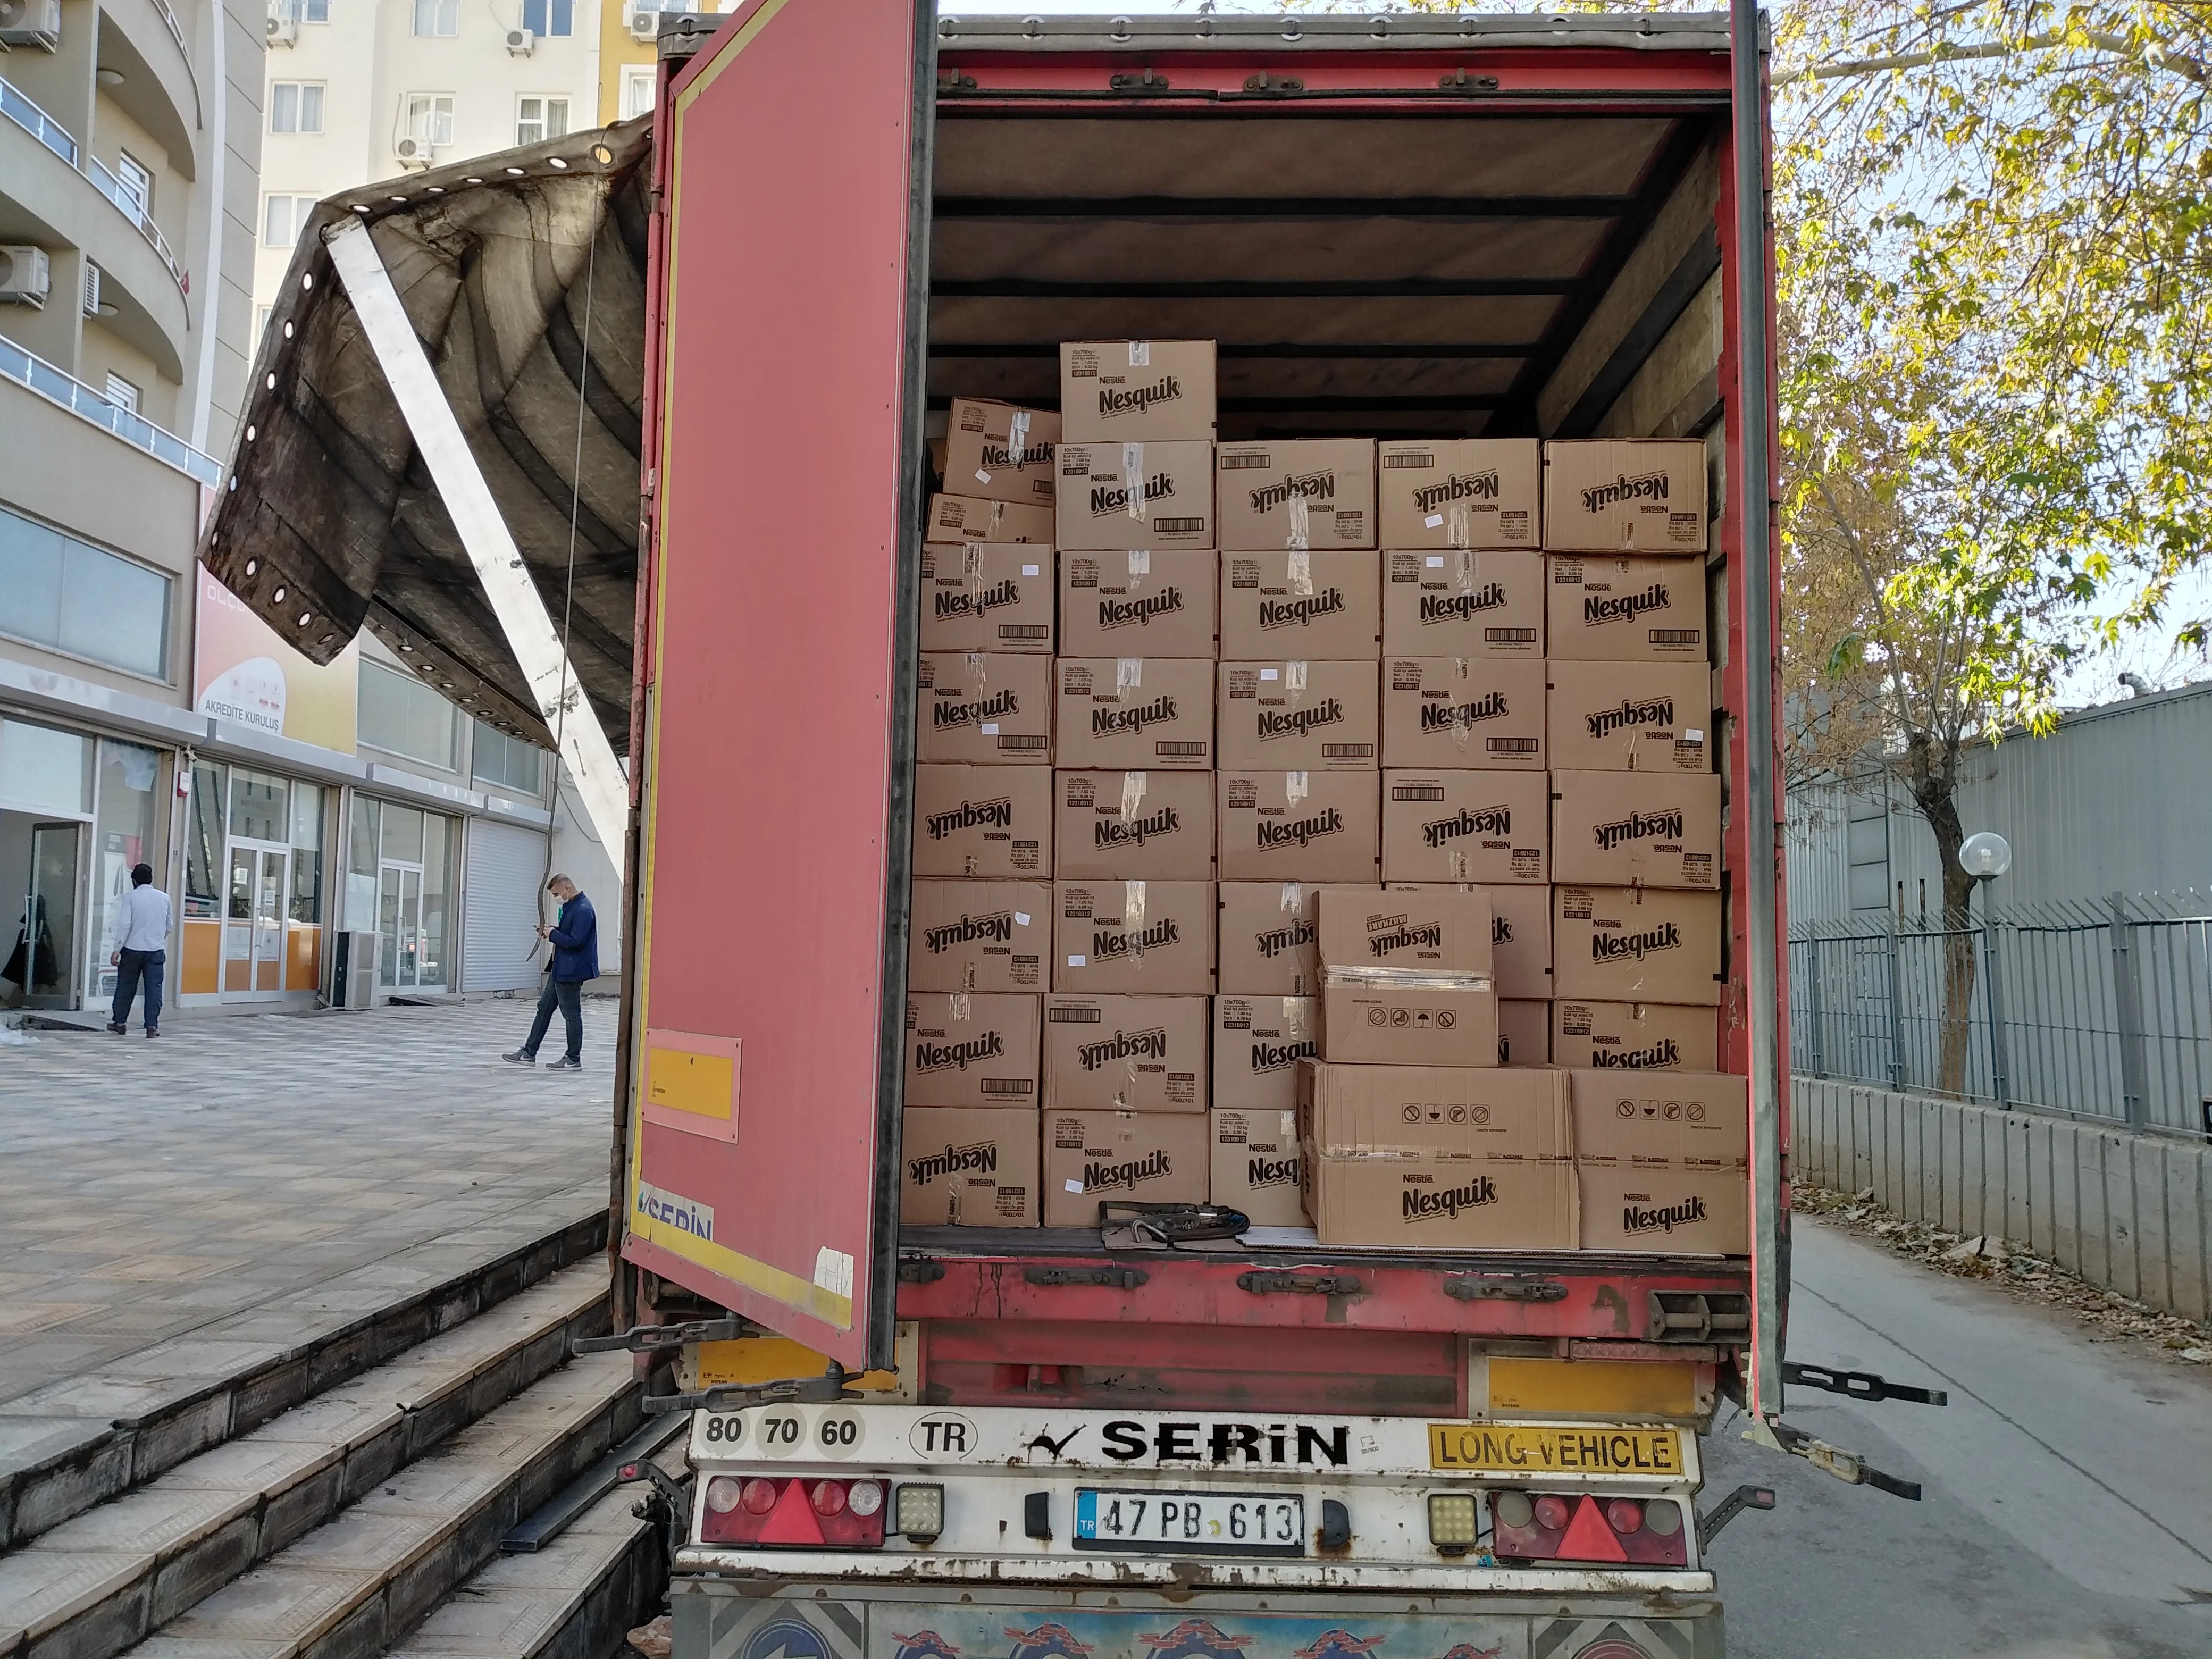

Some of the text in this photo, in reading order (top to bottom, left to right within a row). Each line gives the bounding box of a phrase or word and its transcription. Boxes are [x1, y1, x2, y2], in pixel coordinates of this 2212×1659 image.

[1099, 375, 1182, 414] Nesquik
[1412, 473, 1498, 513] Nesquik
[1580, 474, 1668, 513] Nesquik
[1100, 586, 1184, 625] Nesquik
[1260, 587, 1345, 626] Nesquik
[1420, 582, 1507, 621] Nesquik
[1585, 583, 1671, 622] Nesquik
[205, 699, 243, 720] AKREDİTE
[245, 710, 279, 733] KURULUŞ
[1092, 695, 1178, 734] Nesquik
[1258, 698, 1344, 736] Nesquik
[1585, 699, 1672, 740] Nesquik
[925, 801, 1010, 840] Nesquik
[1258, 808, 1344, 847] Nesquik
[1421, 808, 1510, 849] Nesquik
[1593, 810, 1682, 853] Nesquik
[924, 914, 1010, 954] Nesquik
[1367, 914, 1407, 931] MUZKARE
[1368, 925, 1440, 958] Nesquik
[1593, 919, 1682, 962] Nesquik
[916, 1029, 1005, 1071] Nesquik
[1077, 1030, 1165, 1072] Nesquik
[1252, 1041, 1317, 1071] Nesqu
[907, 1144, 996, 1186] Nesquik
[1084, 1149, 1172, 1191] Nesquik
[1248, 1157, 1300, 1187] Nesq
[1403, 1174, 1498, 1219] Nesquik
[1624, 1193, 1707, 1235] Nesquik
[706, 1417, 742, 1442] 80
[765, 1418, 798, 1443] 70
[821, 1420, 856, 1445] 60
[921, 1421, 966, 1452] TR
[1440, 1431, 1672, 1468] LONG VEHICLE
[1080, 1520, 1094, 1531] TR
[1105, 1499, 1293, 1541] 47 PB 613
